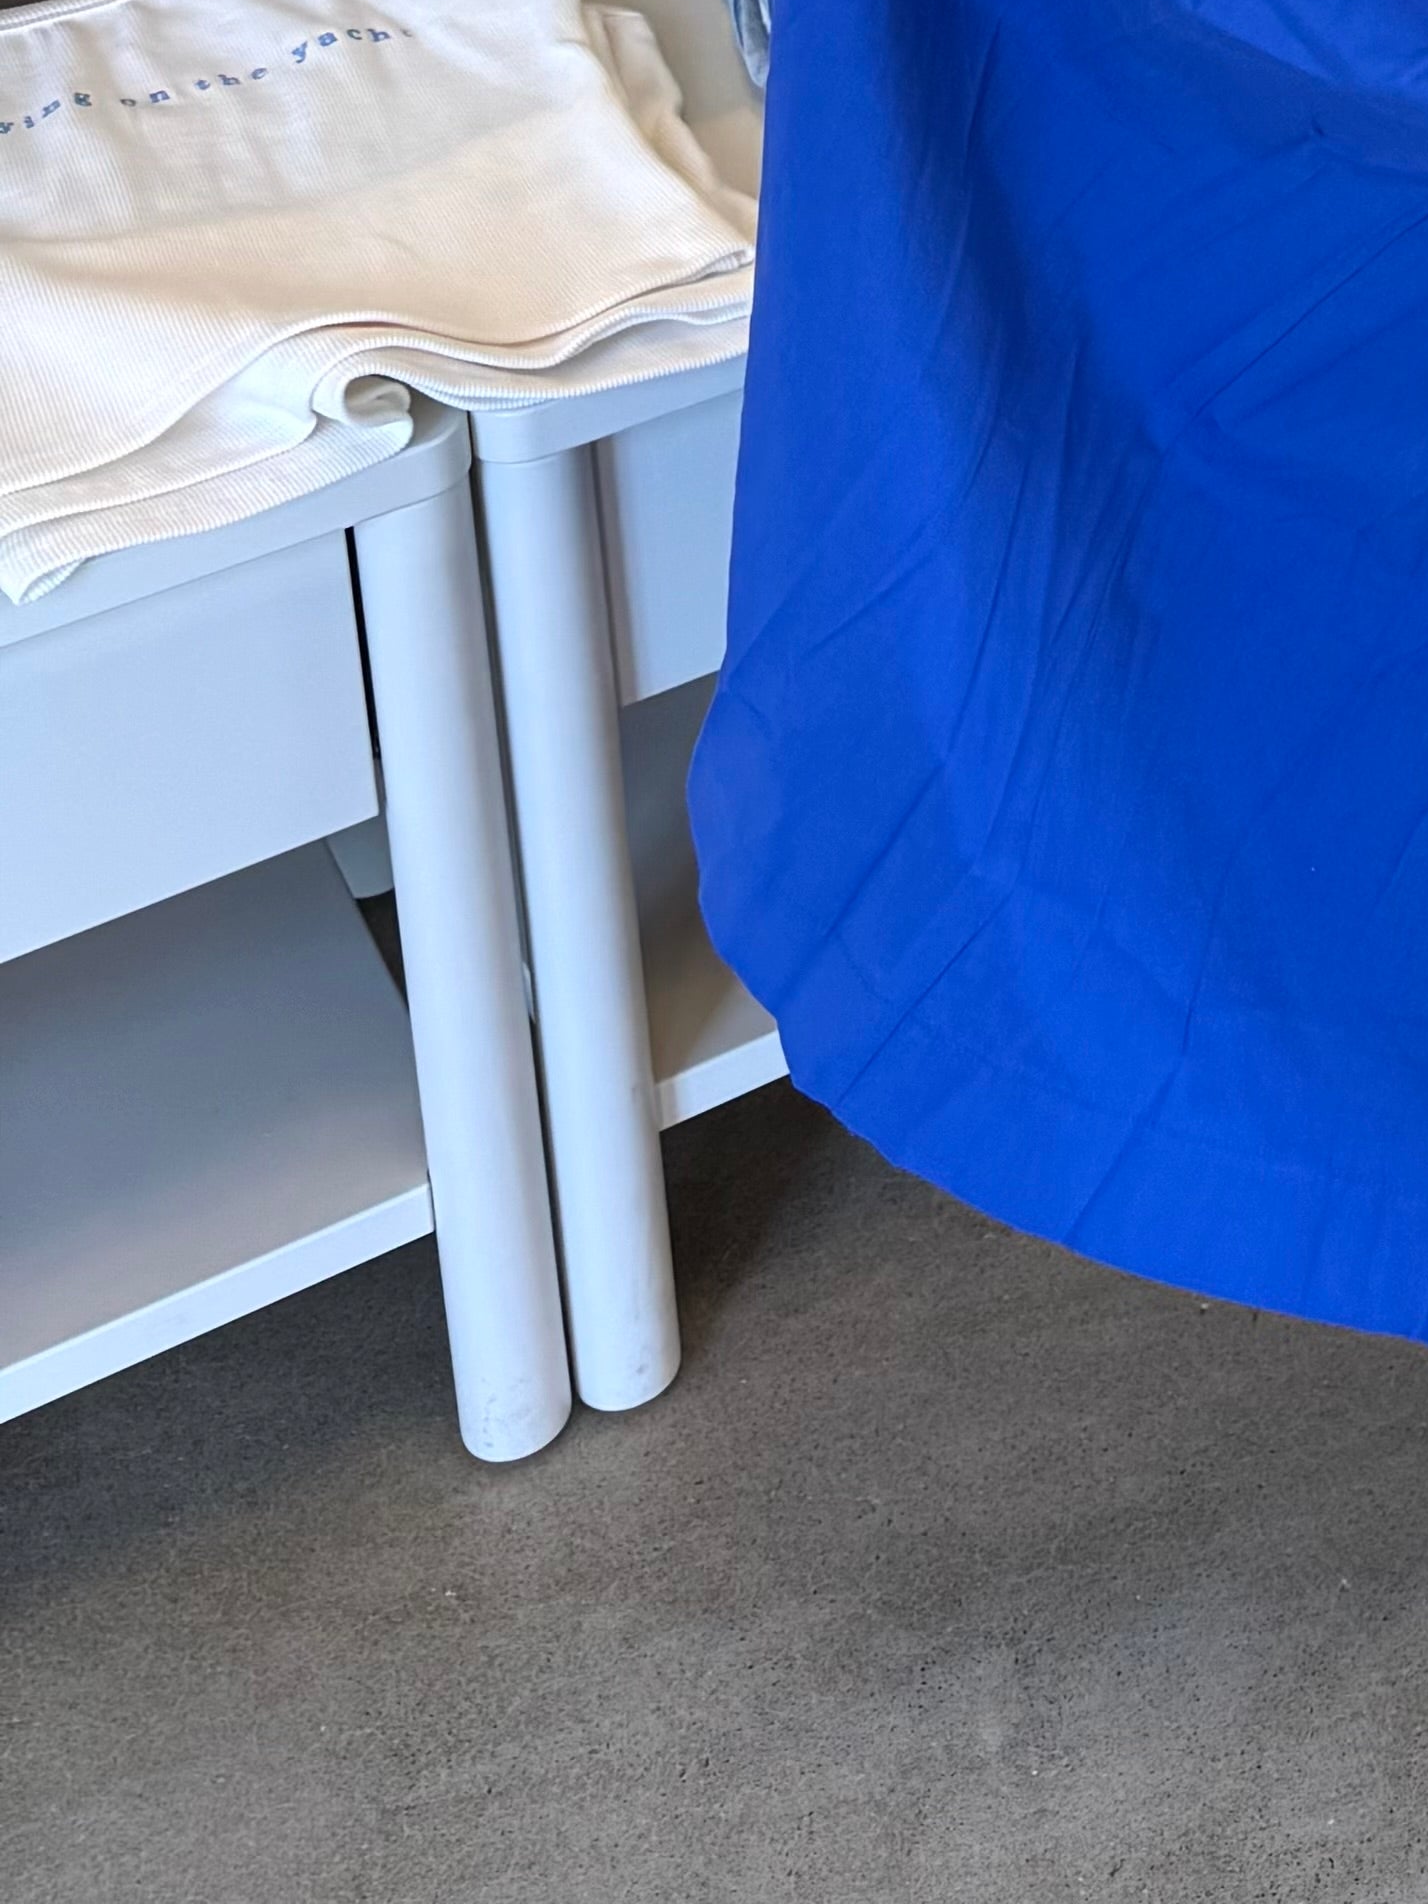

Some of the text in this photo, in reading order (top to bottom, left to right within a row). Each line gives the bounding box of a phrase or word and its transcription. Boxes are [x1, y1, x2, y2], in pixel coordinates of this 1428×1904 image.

[120, 90, 170, 108] on
[194, 67, 267, 91] the
[291, 28, 413, 64] yacht
